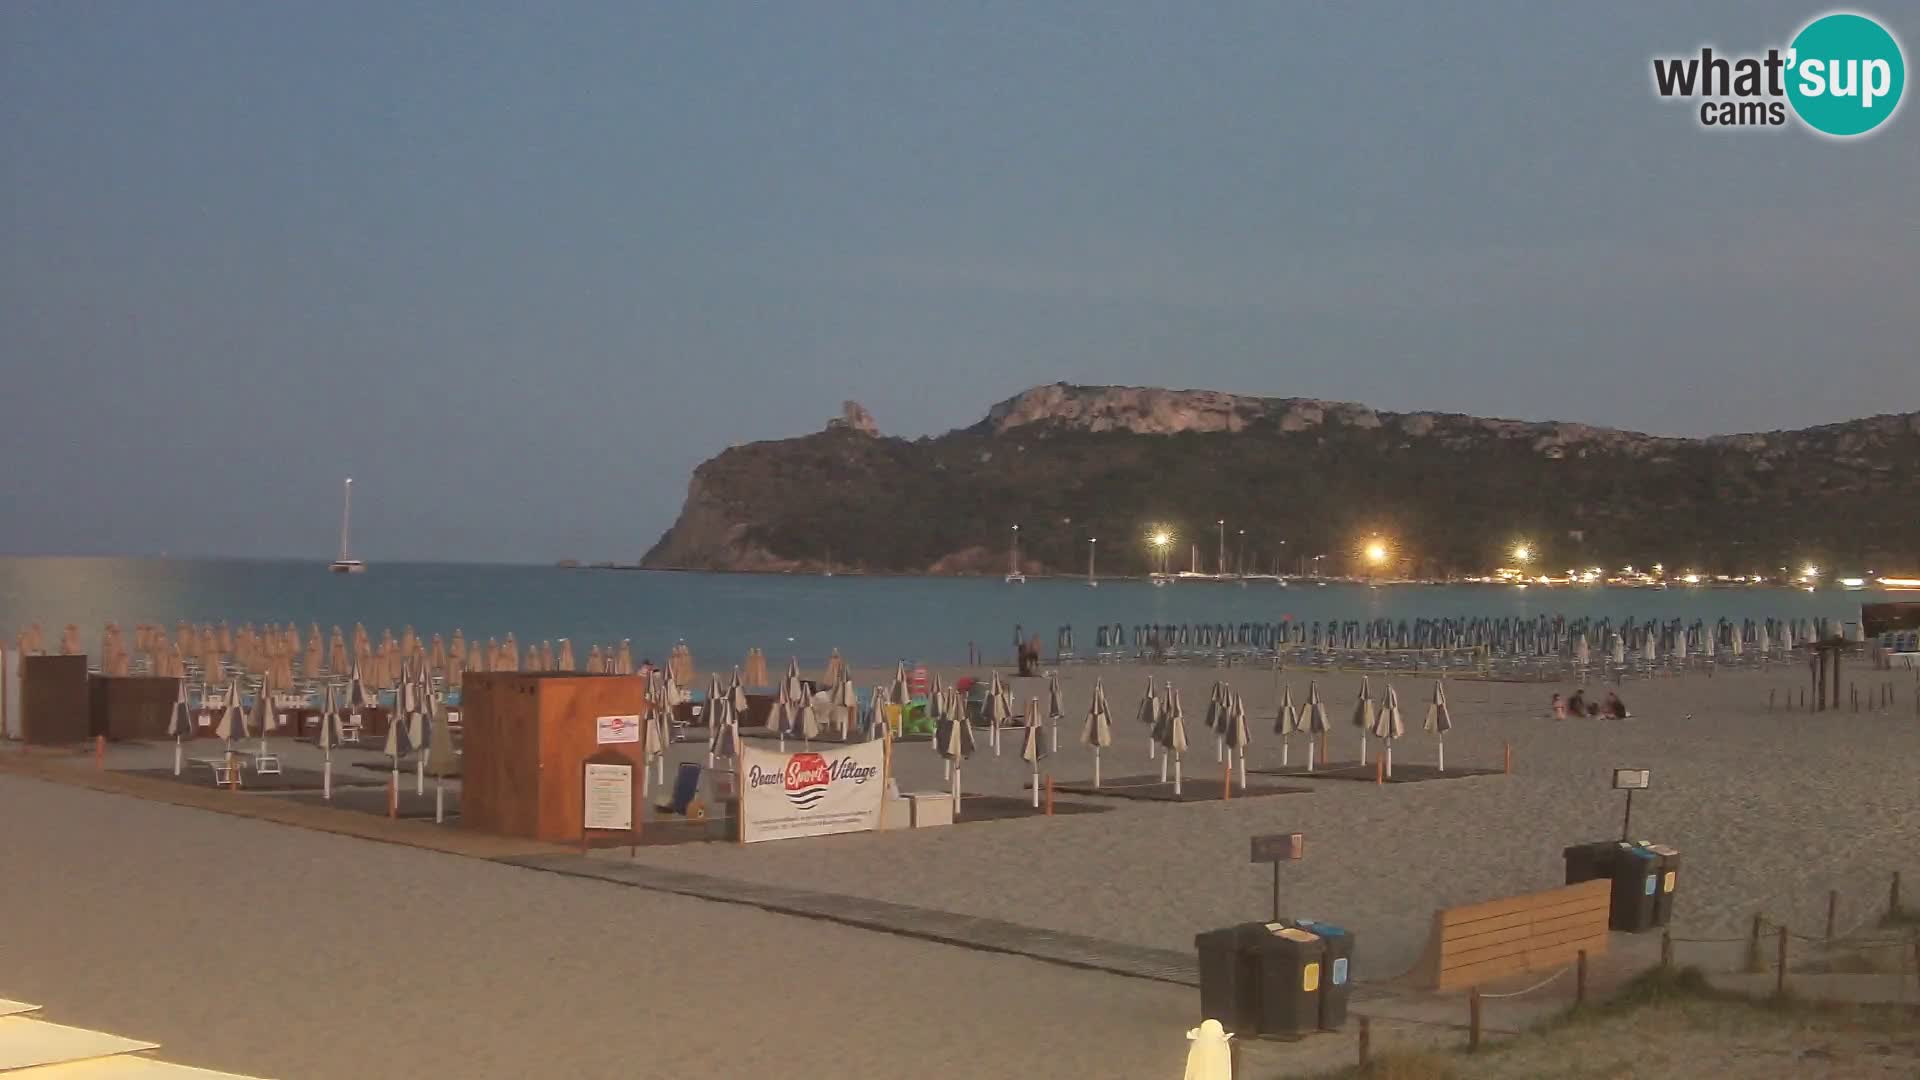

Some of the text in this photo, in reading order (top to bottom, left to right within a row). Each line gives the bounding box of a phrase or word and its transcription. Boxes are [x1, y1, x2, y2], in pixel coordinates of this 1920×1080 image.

[749, 756, 877, 788] Beach Sport Village
